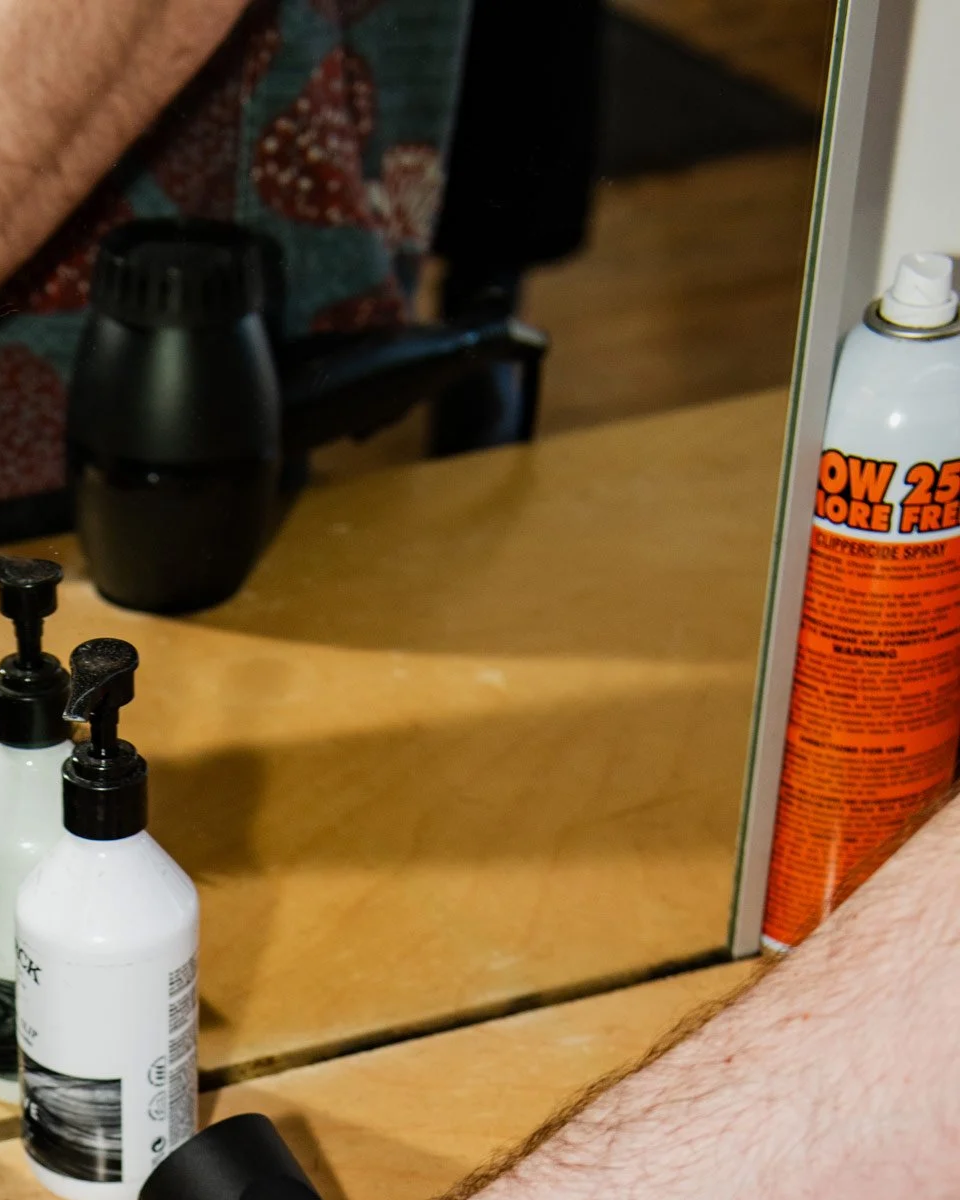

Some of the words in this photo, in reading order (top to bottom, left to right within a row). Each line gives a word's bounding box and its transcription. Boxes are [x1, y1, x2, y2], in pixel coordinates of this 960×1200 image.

[819, 449, 897, 503] OW
[904, 459, 960, 505] 25
[899, 501, 960, 533] FRE
[903, 543, 946, 560] SPRAY
